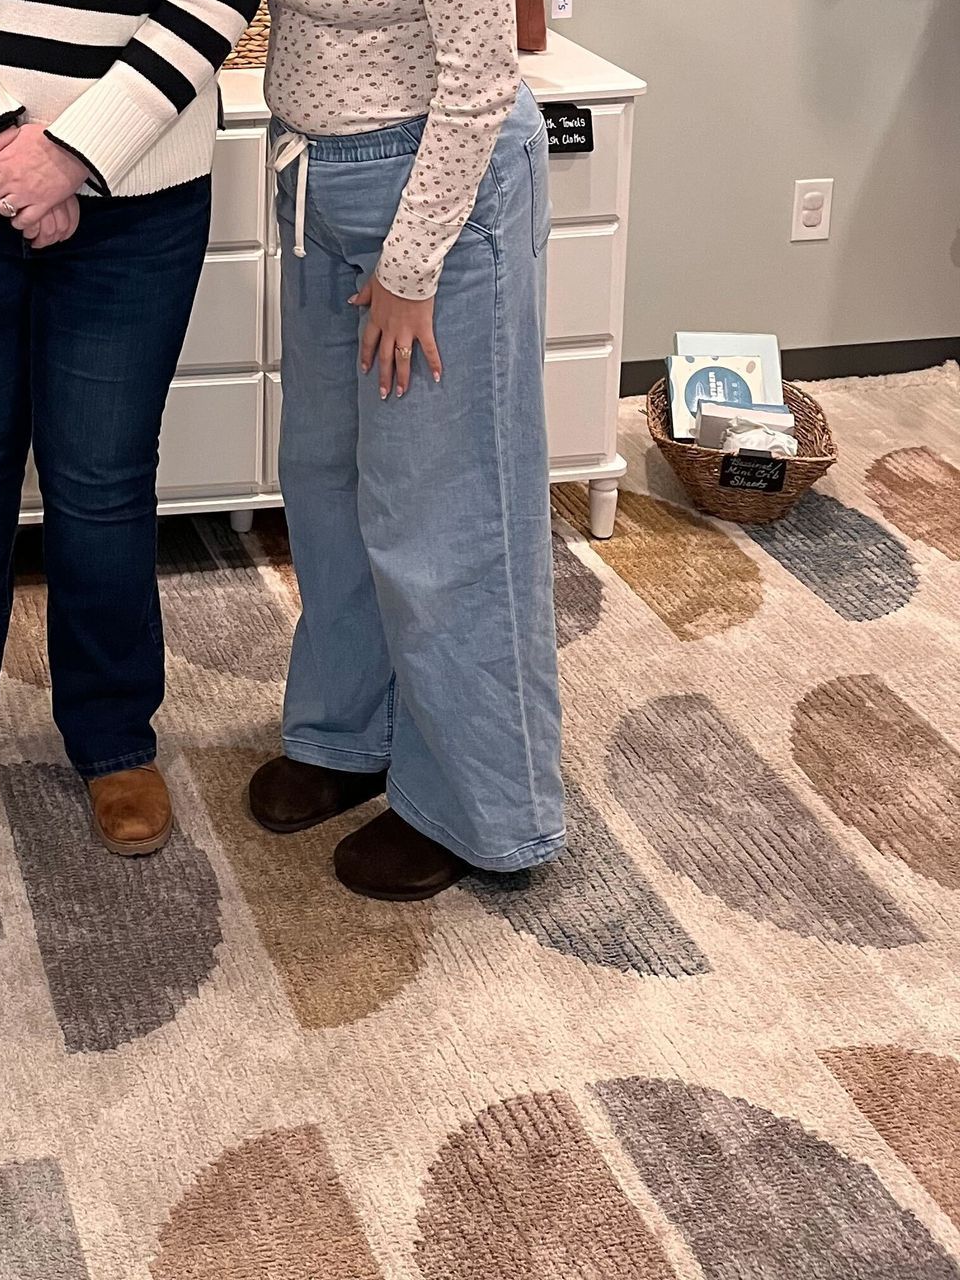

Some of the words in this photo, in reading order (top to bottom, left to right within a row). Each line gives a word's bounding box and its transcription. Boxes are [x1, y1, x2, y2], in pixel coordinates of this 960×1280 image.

[545, 117, 558, 130] th
[558, 116, 587, 128] Towels
[548, 134, 560, 145] sh
[561, 133, 587, 145] Cloths
